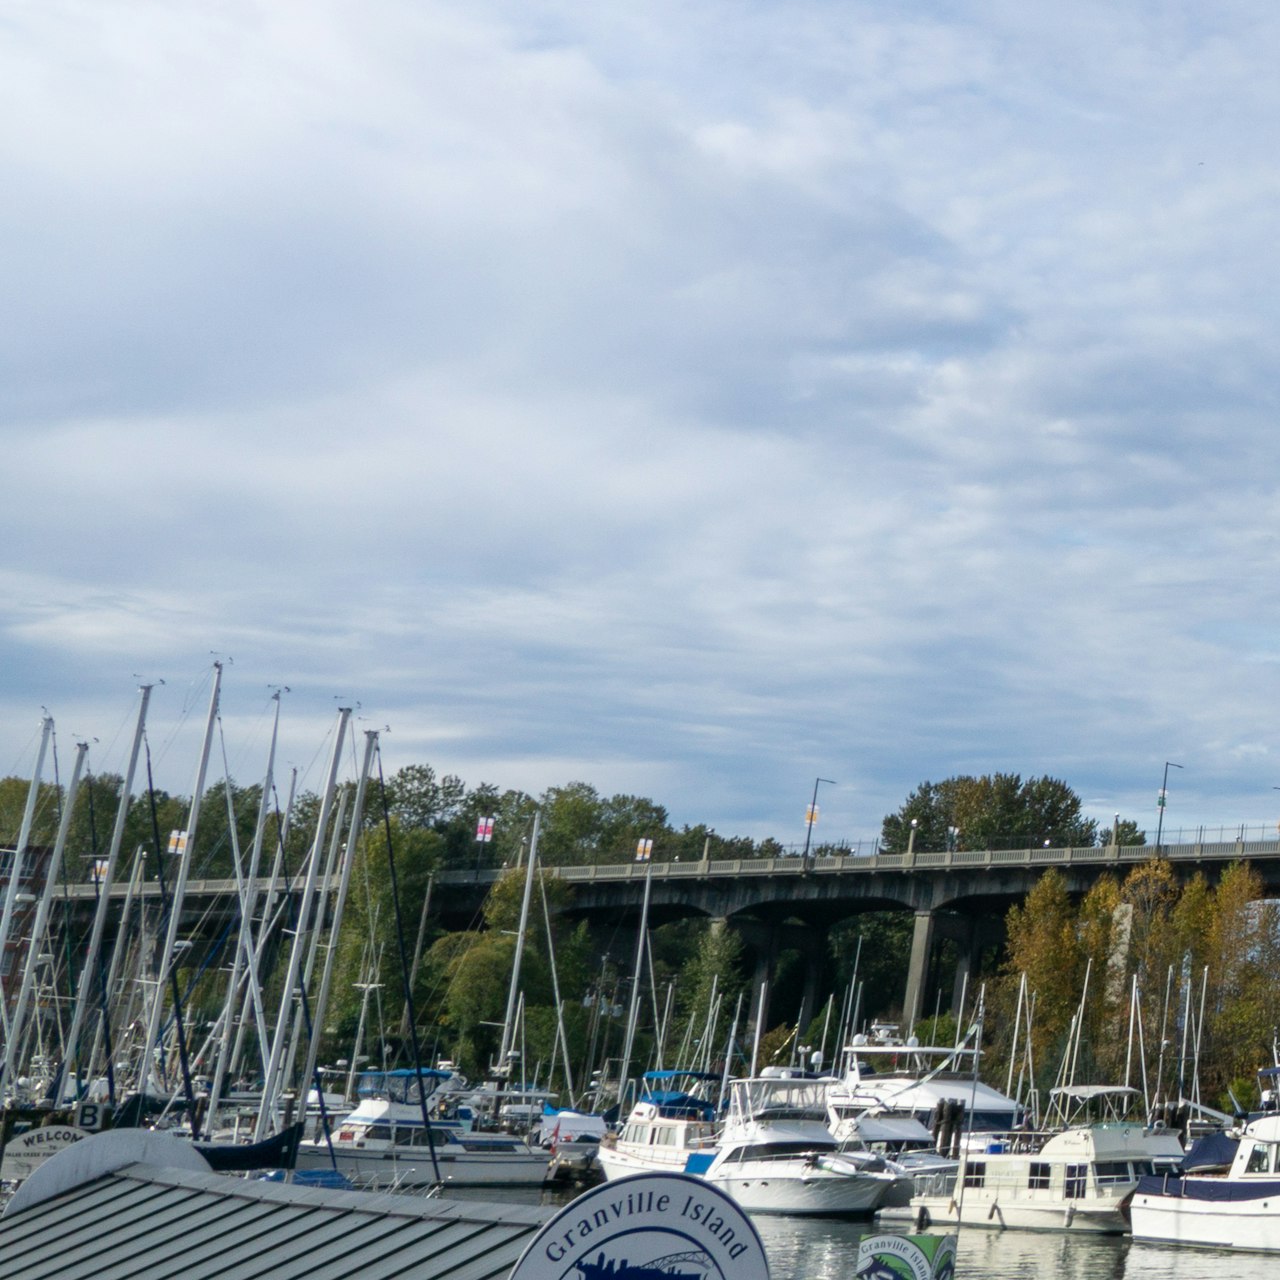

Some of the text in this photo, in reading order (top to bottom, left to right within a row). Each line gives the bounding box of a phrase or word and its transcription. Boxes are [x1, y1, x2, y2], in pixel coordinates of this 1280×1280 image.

[80, 1105, 98, 1126] B
[23, 1131, 84, 1147] WELCOM
[545, 1191, 748, 1262] Granville Island
[861, 1240, 909, 1254] Granville
